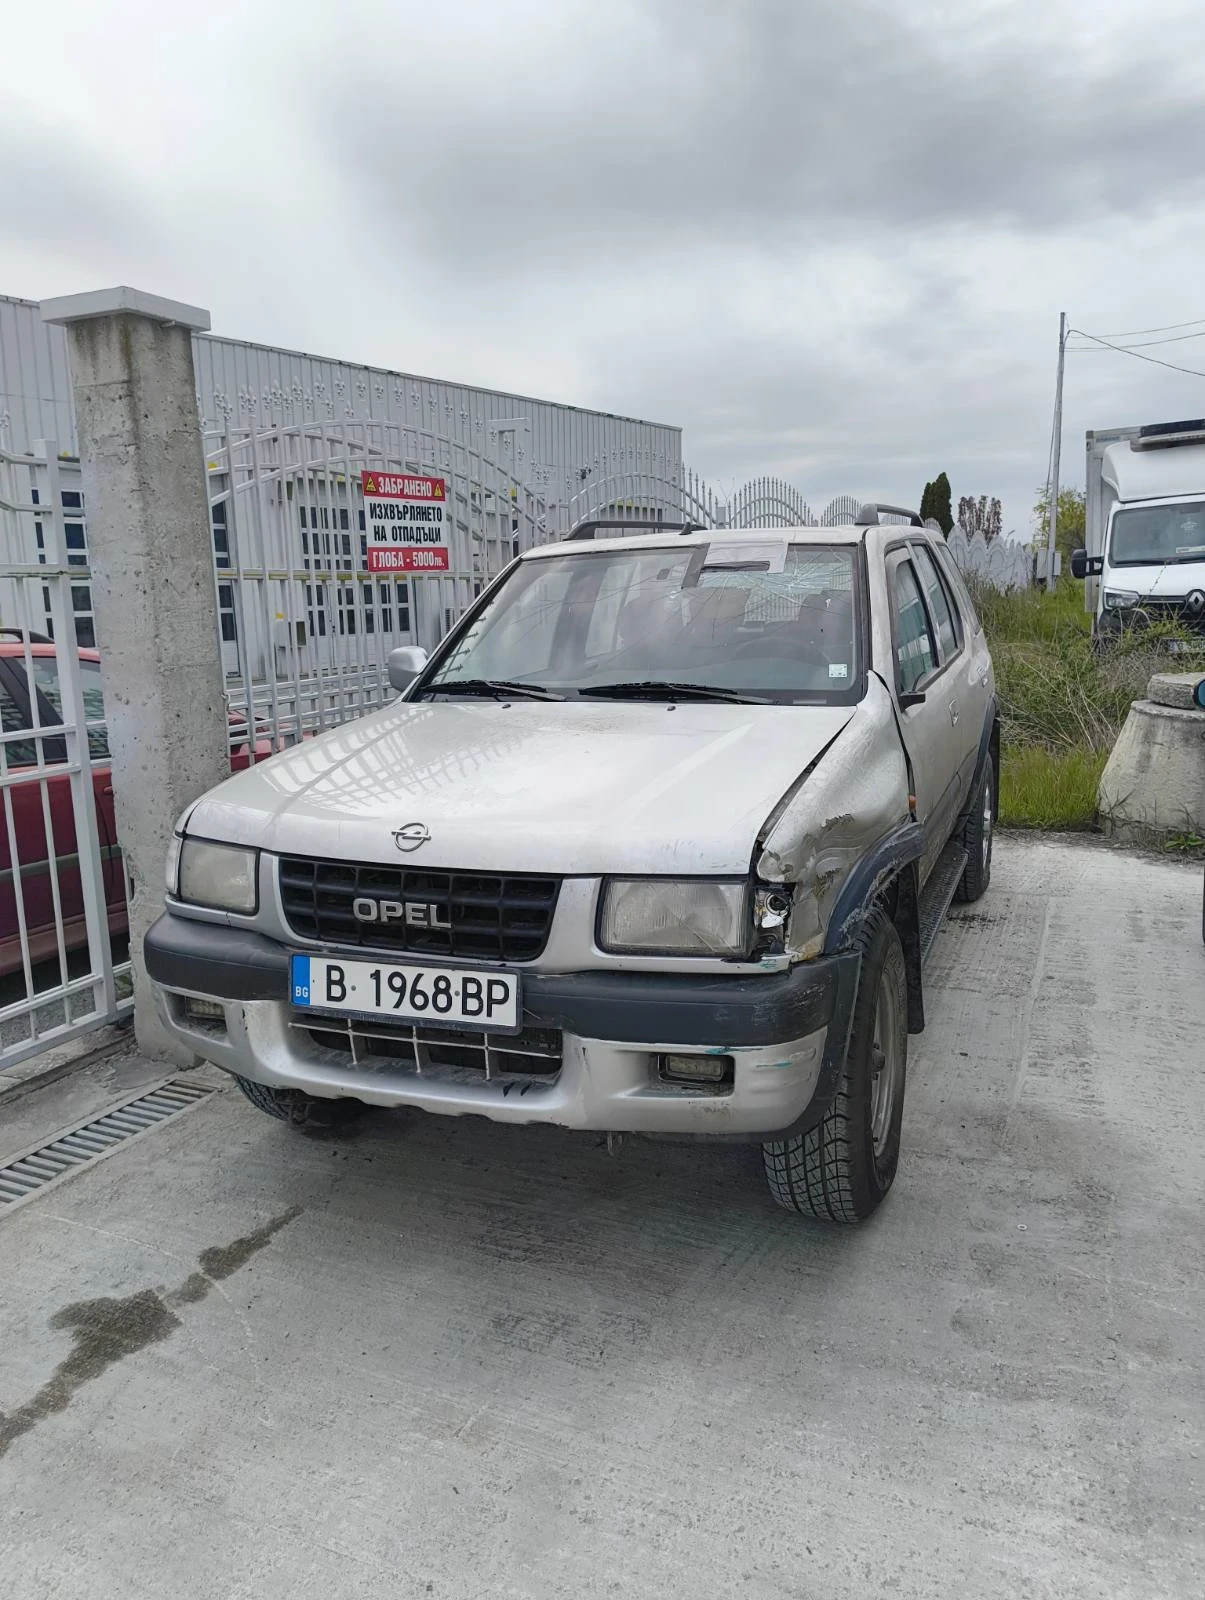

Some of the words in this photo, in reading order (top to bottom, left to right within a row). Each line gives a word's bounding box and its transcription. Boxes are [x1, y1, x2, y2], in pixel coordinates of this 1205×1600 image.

[378, 477, 432, 497] ЗАБРАНЕНО
[369, 502, 443, 522] ИЗХВЪРЛЯНЕТО
[373, 525, 387, 542] НА
[391, 526, 441, 544] ОТПАДЪЦИ
[372, 551, 405, 568] ГЛОБА
[353, 898, 452, 929] OPEL
[295, 986, 309, 998] BG
[326, 965, 347, 1002] B
[370, 969, 453, 1014] 1968
[461, 976, 510, 1018] BP
